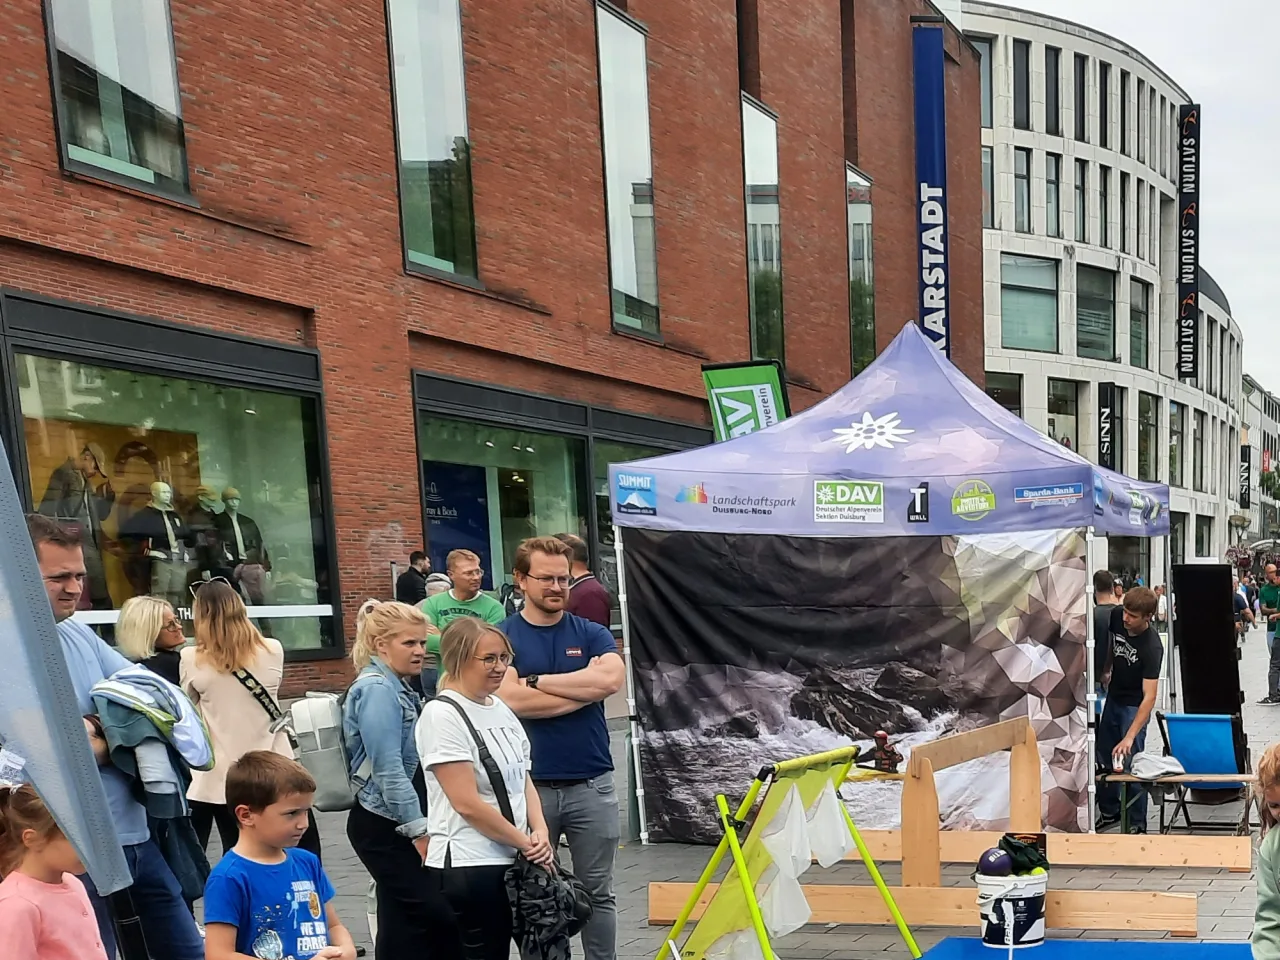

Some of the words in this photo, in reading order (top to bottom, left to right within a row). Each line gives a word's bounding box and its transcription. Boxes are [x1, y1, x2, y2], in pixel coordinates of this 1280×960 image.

[1182, 138, 1195, 193] SATURN
[1181, 229, 1195, 284] SATURN
[1181, 319, 1194, 372] SATURN
[1101, 407, 1111, 454] SINN
[836, 485, 879, 502] DAV
[1023, 486, 1075, 498] Sparda-Bank
[1240, 462, 1250, 499] SINN
[712, 494, 797, 508] Landschaftspark
[847, 506, 882, 514] Alpenverein
